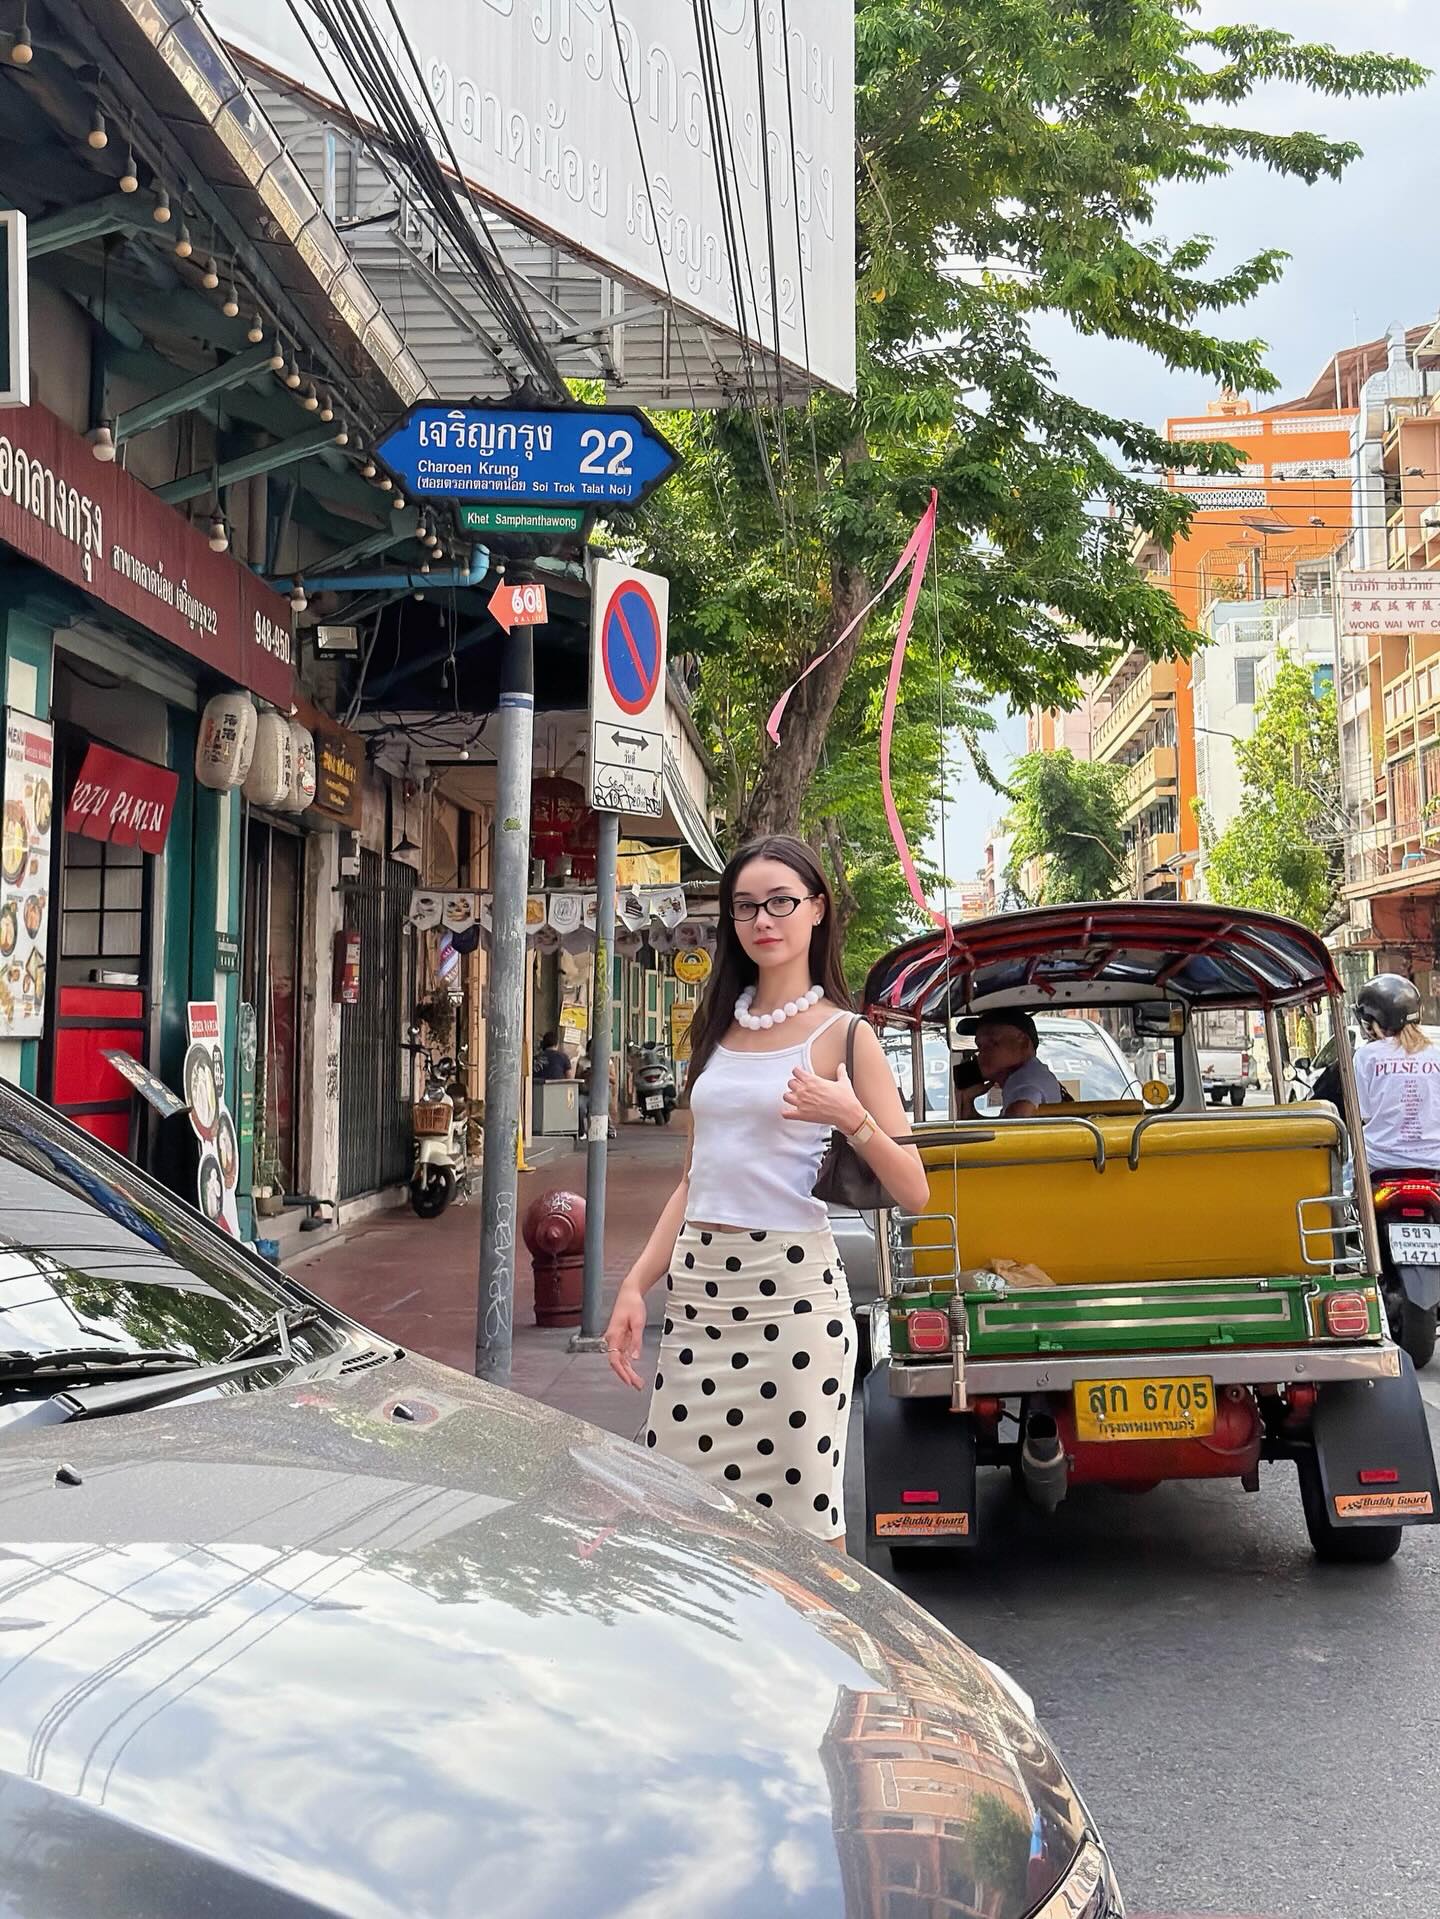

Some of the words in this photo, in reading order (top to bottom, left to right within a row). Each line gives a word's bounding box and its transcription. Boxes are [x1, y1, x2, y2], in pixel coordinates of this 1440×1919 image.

[418, 410, 553, 461] เจริญกรุง
[580, 429, 633, 475] 22
[418, 460, 472, 474] Charoen
[478, 462, 519, 478] Krung
[532, 482, 548, 492] Soi
[553, 482, 575, 493] Trok
[582, 483, 604, 494] Talat
[609, 484, 632, 496] Noi)
[467, 513, 489, 525] Khet
[495, 513, 577, 529] Samphanthawong
[112, 544, 174, 606] สาขาตลาดน้อย
[255, 610, 290, 665] 948-950
[1349, 621, 1380, 629] WONG
[1385, 620, 1403, 629] WAI
[1408, 620, 1425, 628] WIT
[109, 791, 164, 832] RAMEN
[1375, 1062, 1419, 1076] PULSE
[1401, 1227, 1431, 1239] 5ขจ
[1402, 1250, 1437, 1264] 1471
[1143, 1382, 1208, 1411] 6705
[1361, 1496, 1394, 1508] Buddy
[1397, 1494, 1429, 1505] Guard
[901, 1516, 933, 1527] Buddy
[936, 1515, 966, 1527] Guard
